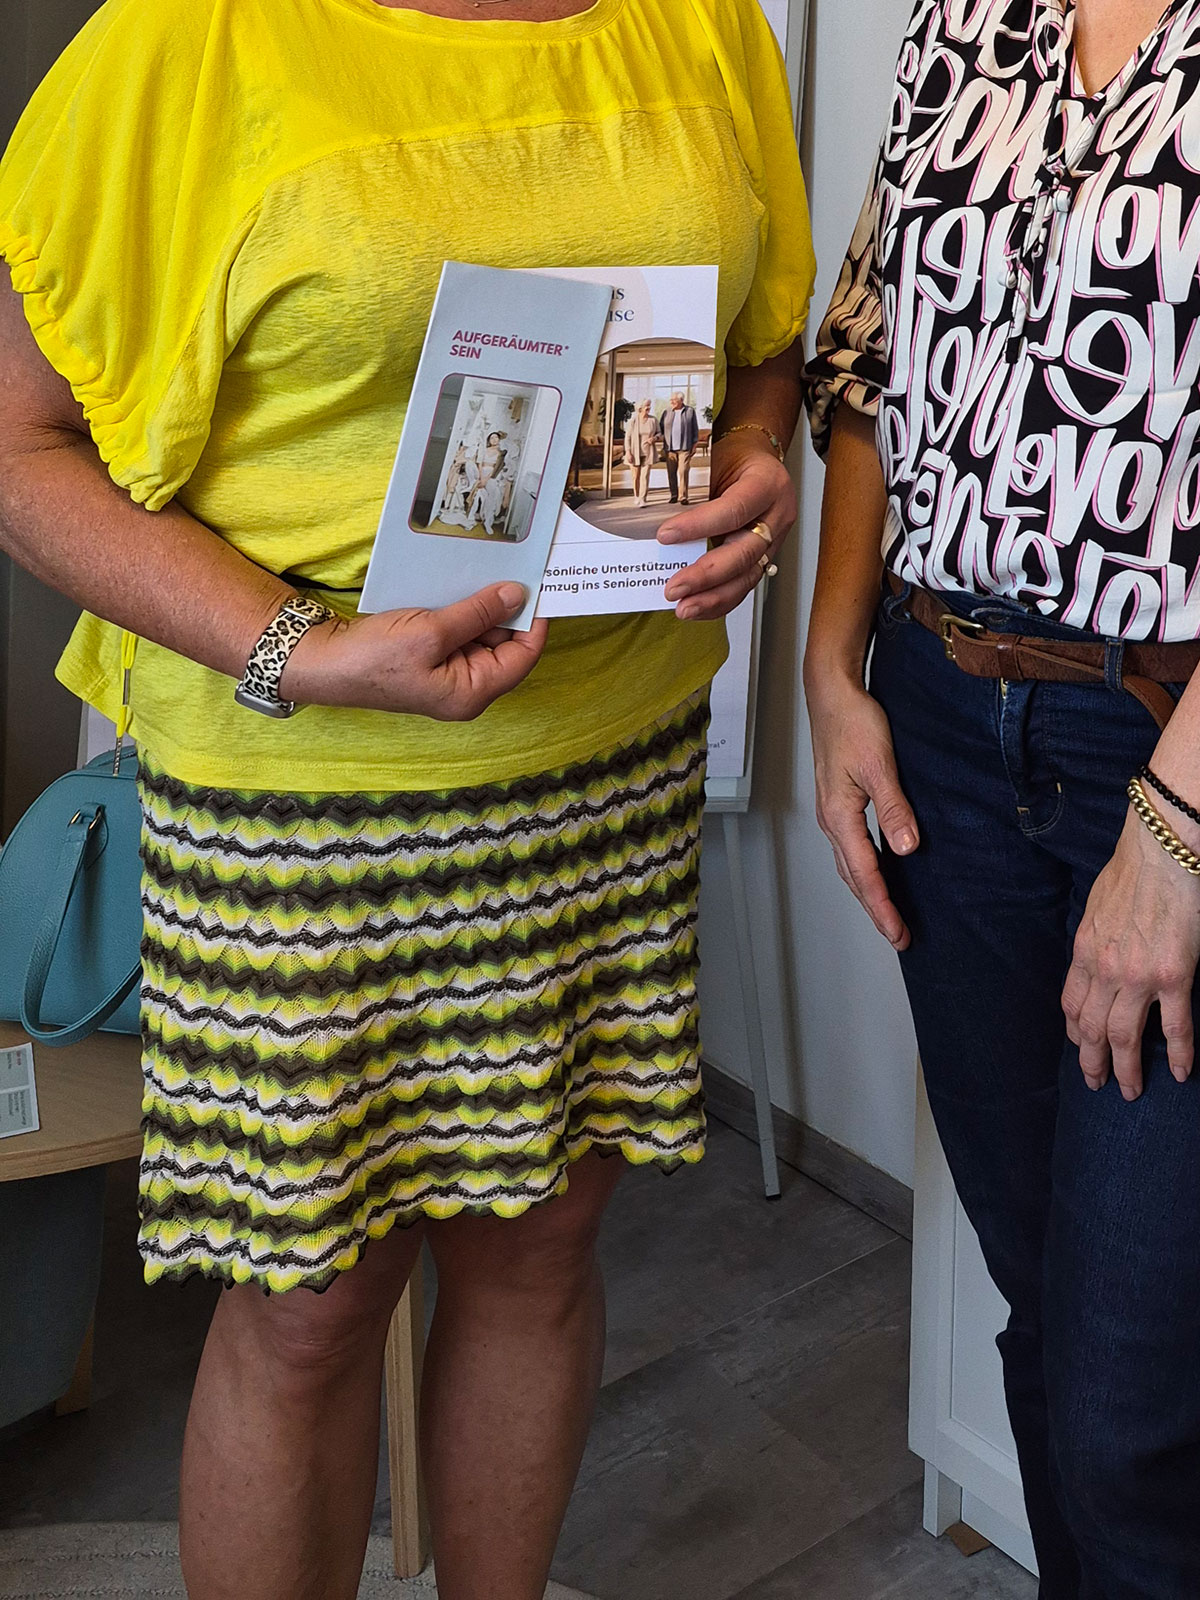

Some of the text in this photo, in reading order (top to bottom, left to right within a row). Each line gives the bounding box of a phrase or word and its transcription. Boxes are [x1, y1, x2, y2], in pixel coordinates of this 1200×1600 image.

[449, 344, 482, 360] SEIN
[601, 560, 689, 575] Unterstützung
[582, 580, 600, 590] ins
